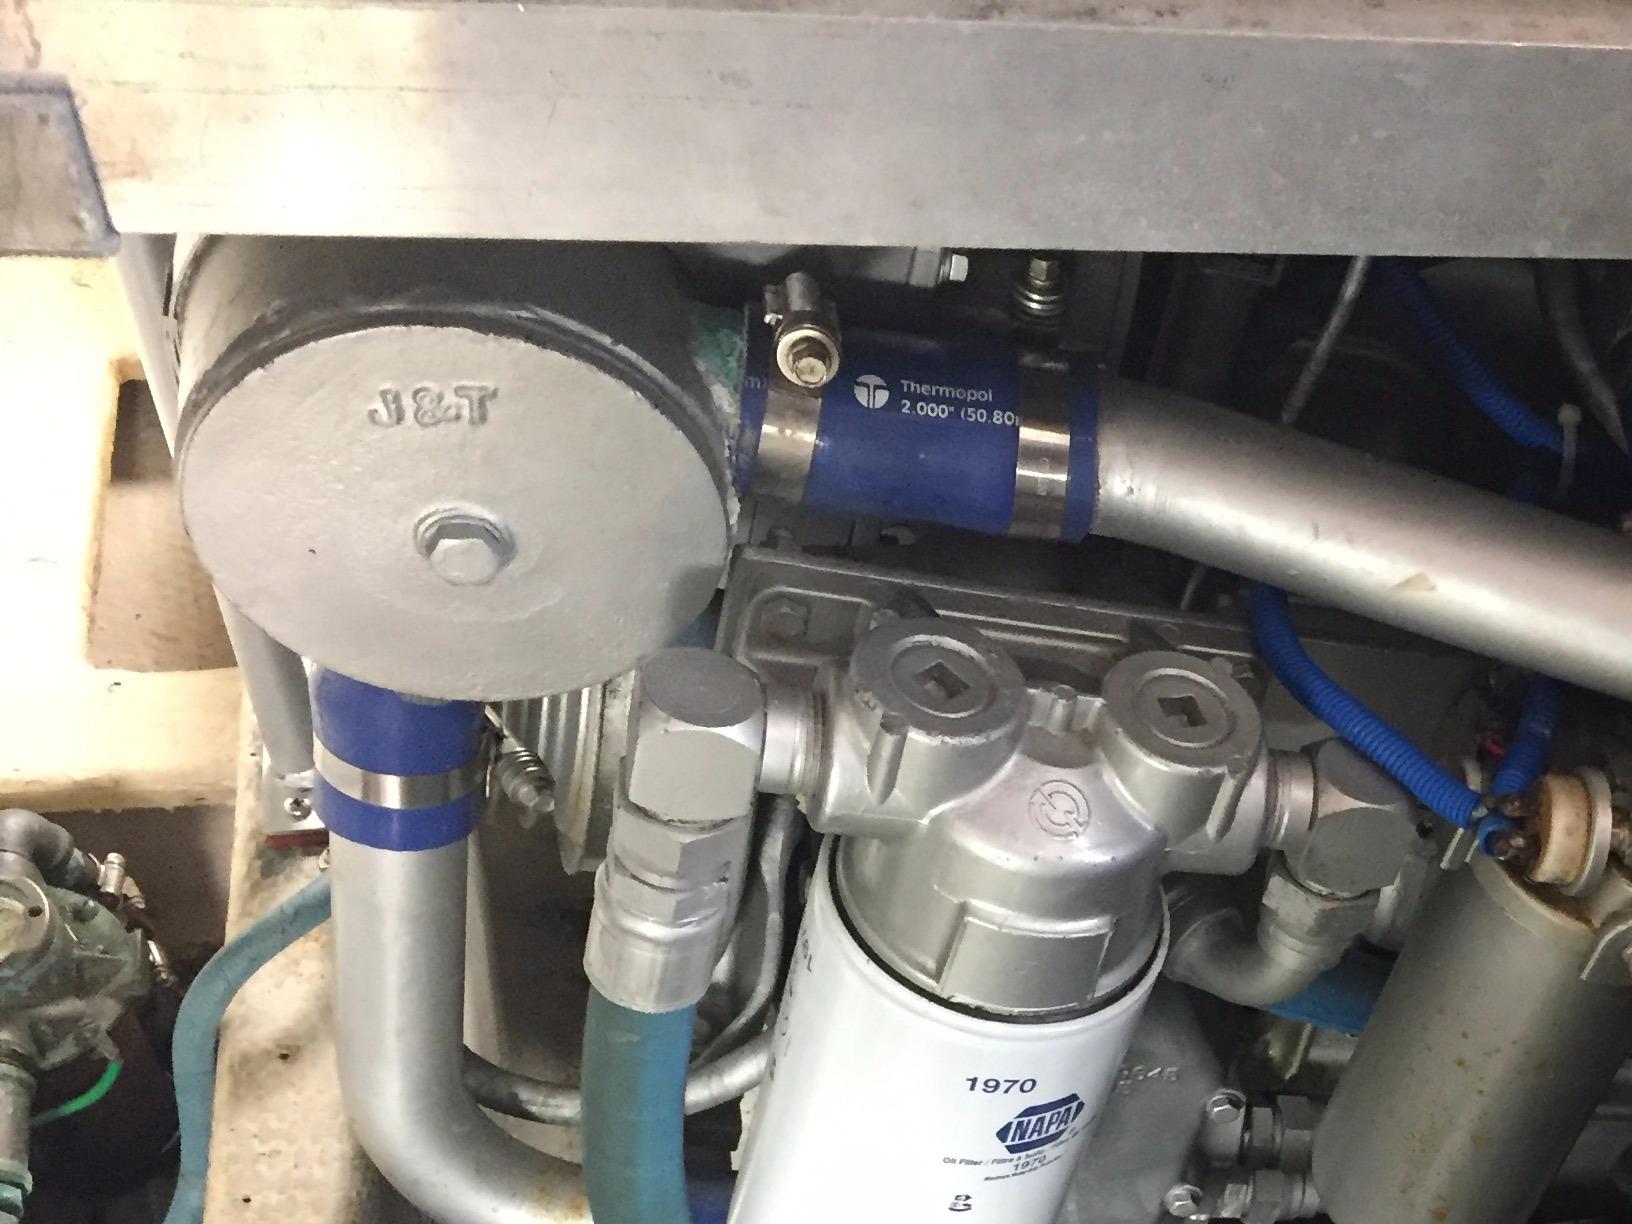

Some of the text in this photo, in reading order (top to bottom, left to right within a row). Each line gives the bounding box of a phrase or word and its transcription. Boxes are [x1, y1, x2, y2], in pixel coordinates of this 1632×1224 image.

[901, 379, 993, 402] Thermopol
[366, 384, 500, 428] J&T
[901, 399, 1022, 427] 2.000" (50.80
[965, 1076, 1038, 1094] 1970
[1010, 1106, 1071, 1142] NAPA
[1012, 1155, 1047, 1172] 1970
